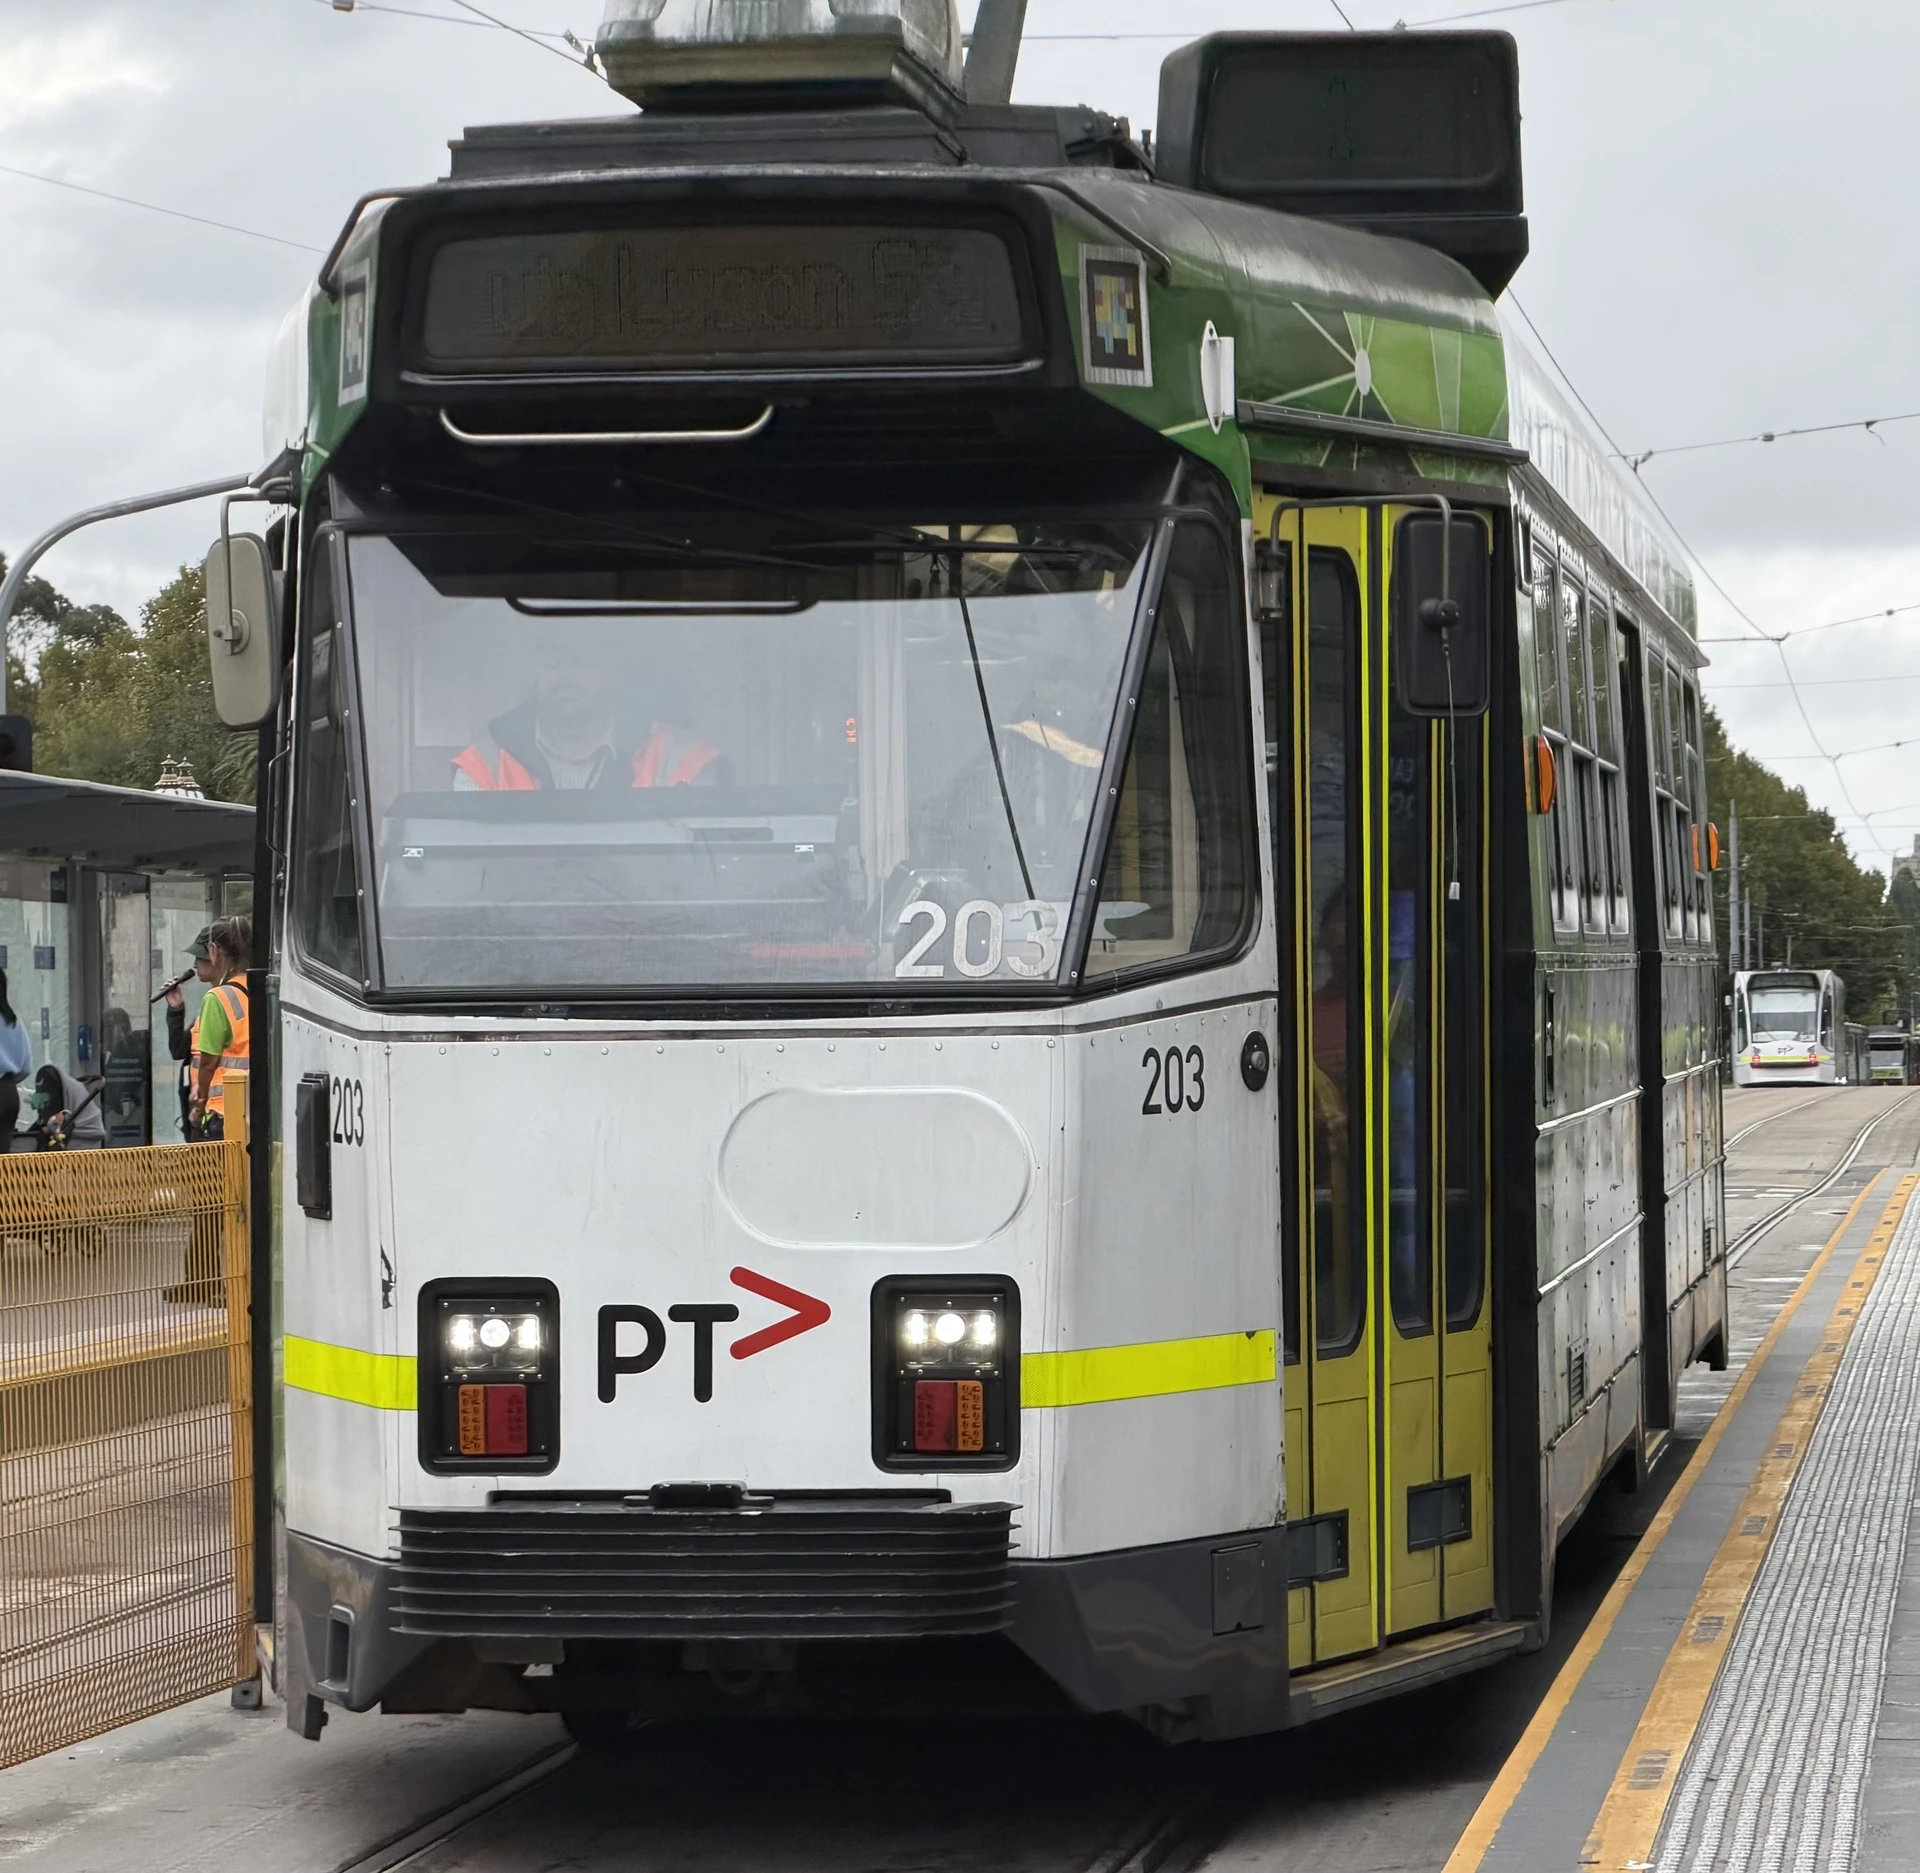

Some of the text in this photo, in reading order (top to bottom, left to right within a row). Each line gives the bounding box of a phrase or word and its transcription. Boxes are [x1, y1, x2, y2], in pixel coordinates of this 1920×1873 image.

[895, 899, 1058, 978] 203
[332, 1076, 364, 1147] 203
[1142, 1044, 1205, 1115] 203
